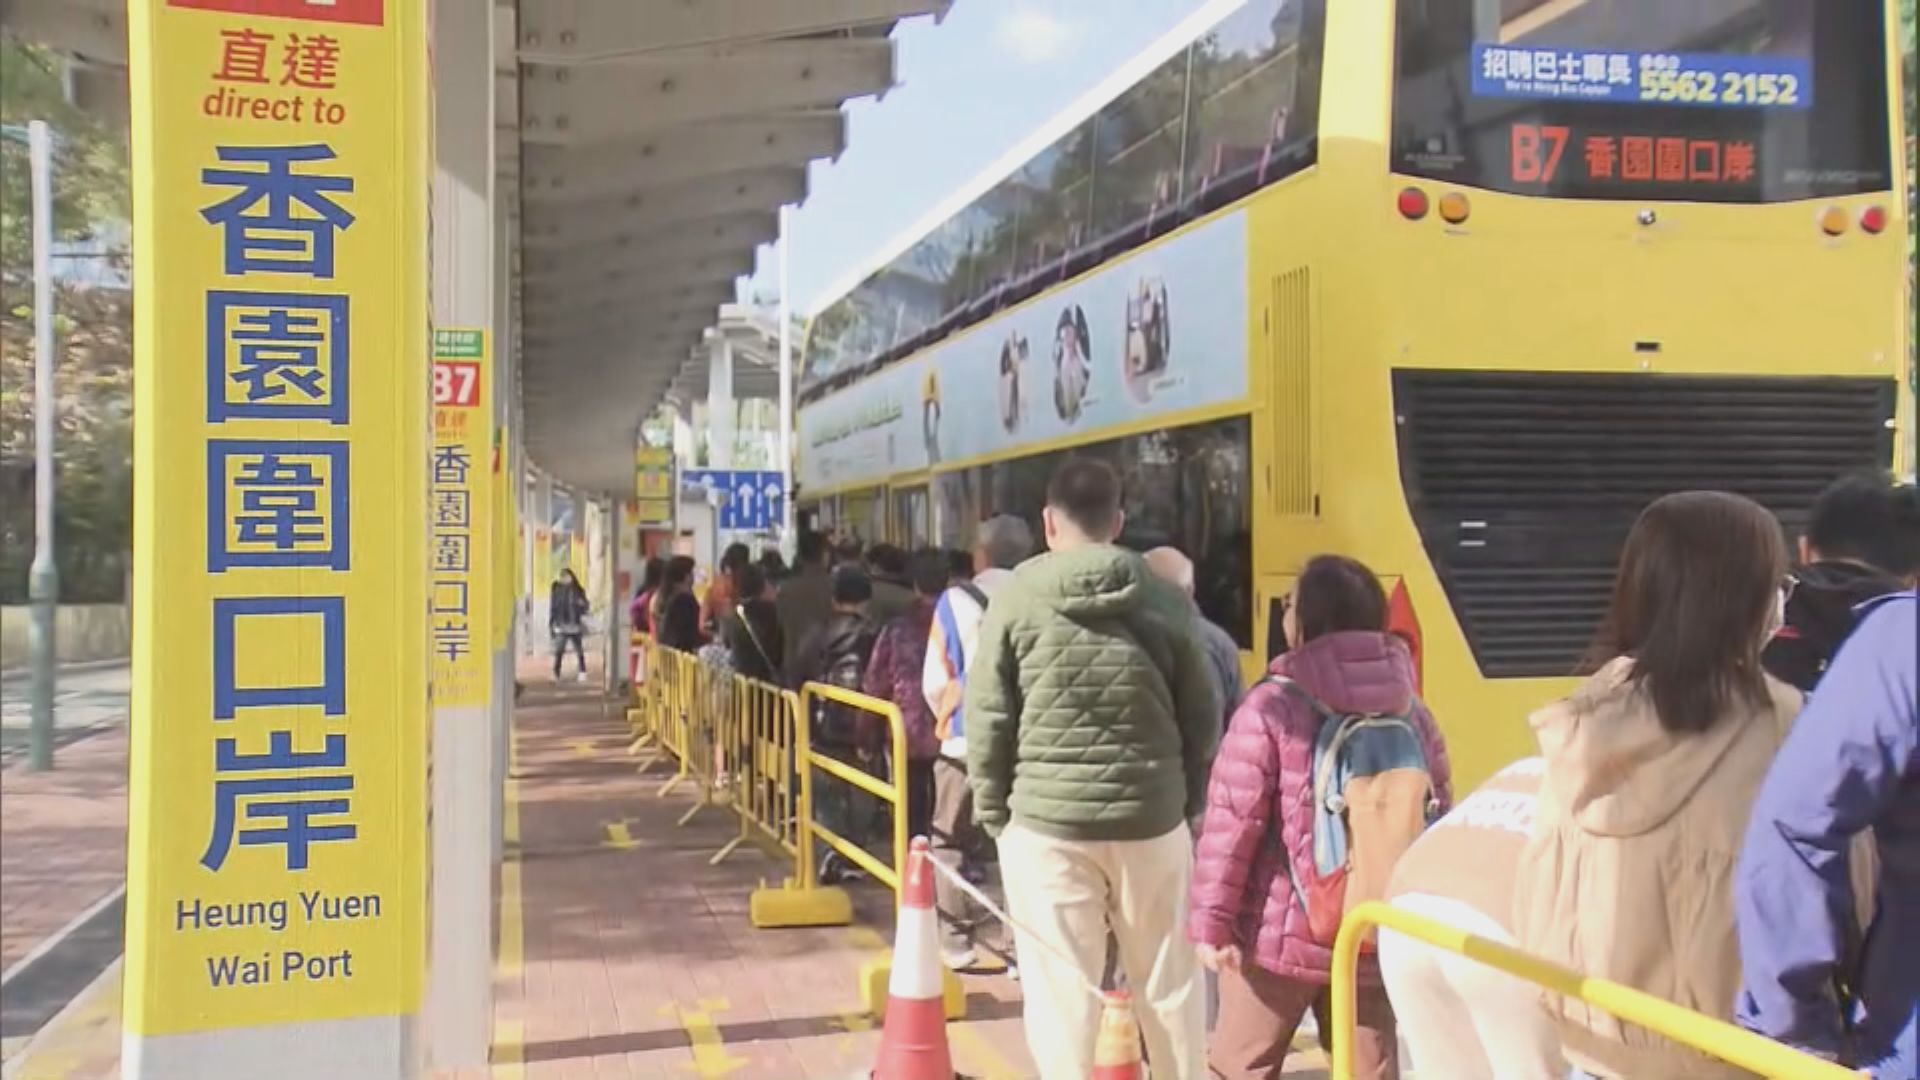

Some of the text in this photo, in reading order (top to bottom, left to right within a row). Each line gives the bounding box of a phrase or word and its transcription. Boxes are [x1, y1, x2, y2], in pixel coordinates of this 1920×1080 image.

[212, 28, 340, 89] 直達
[1483, 48, 1632, 85] 招聘巴士車長
[203, 86, 346, 125] direct to
[1639, 69, 1799, 104] 5562 2152
[1512, 124, 1756, 183] B7 香園圍口岸
[433, 364, 477, 404] B7
[199, 144, 356, 872] 香園圍口岸
[175, 890, 381, 931] Heung Yuen
[207, 950, 353, 987] Wai Port
